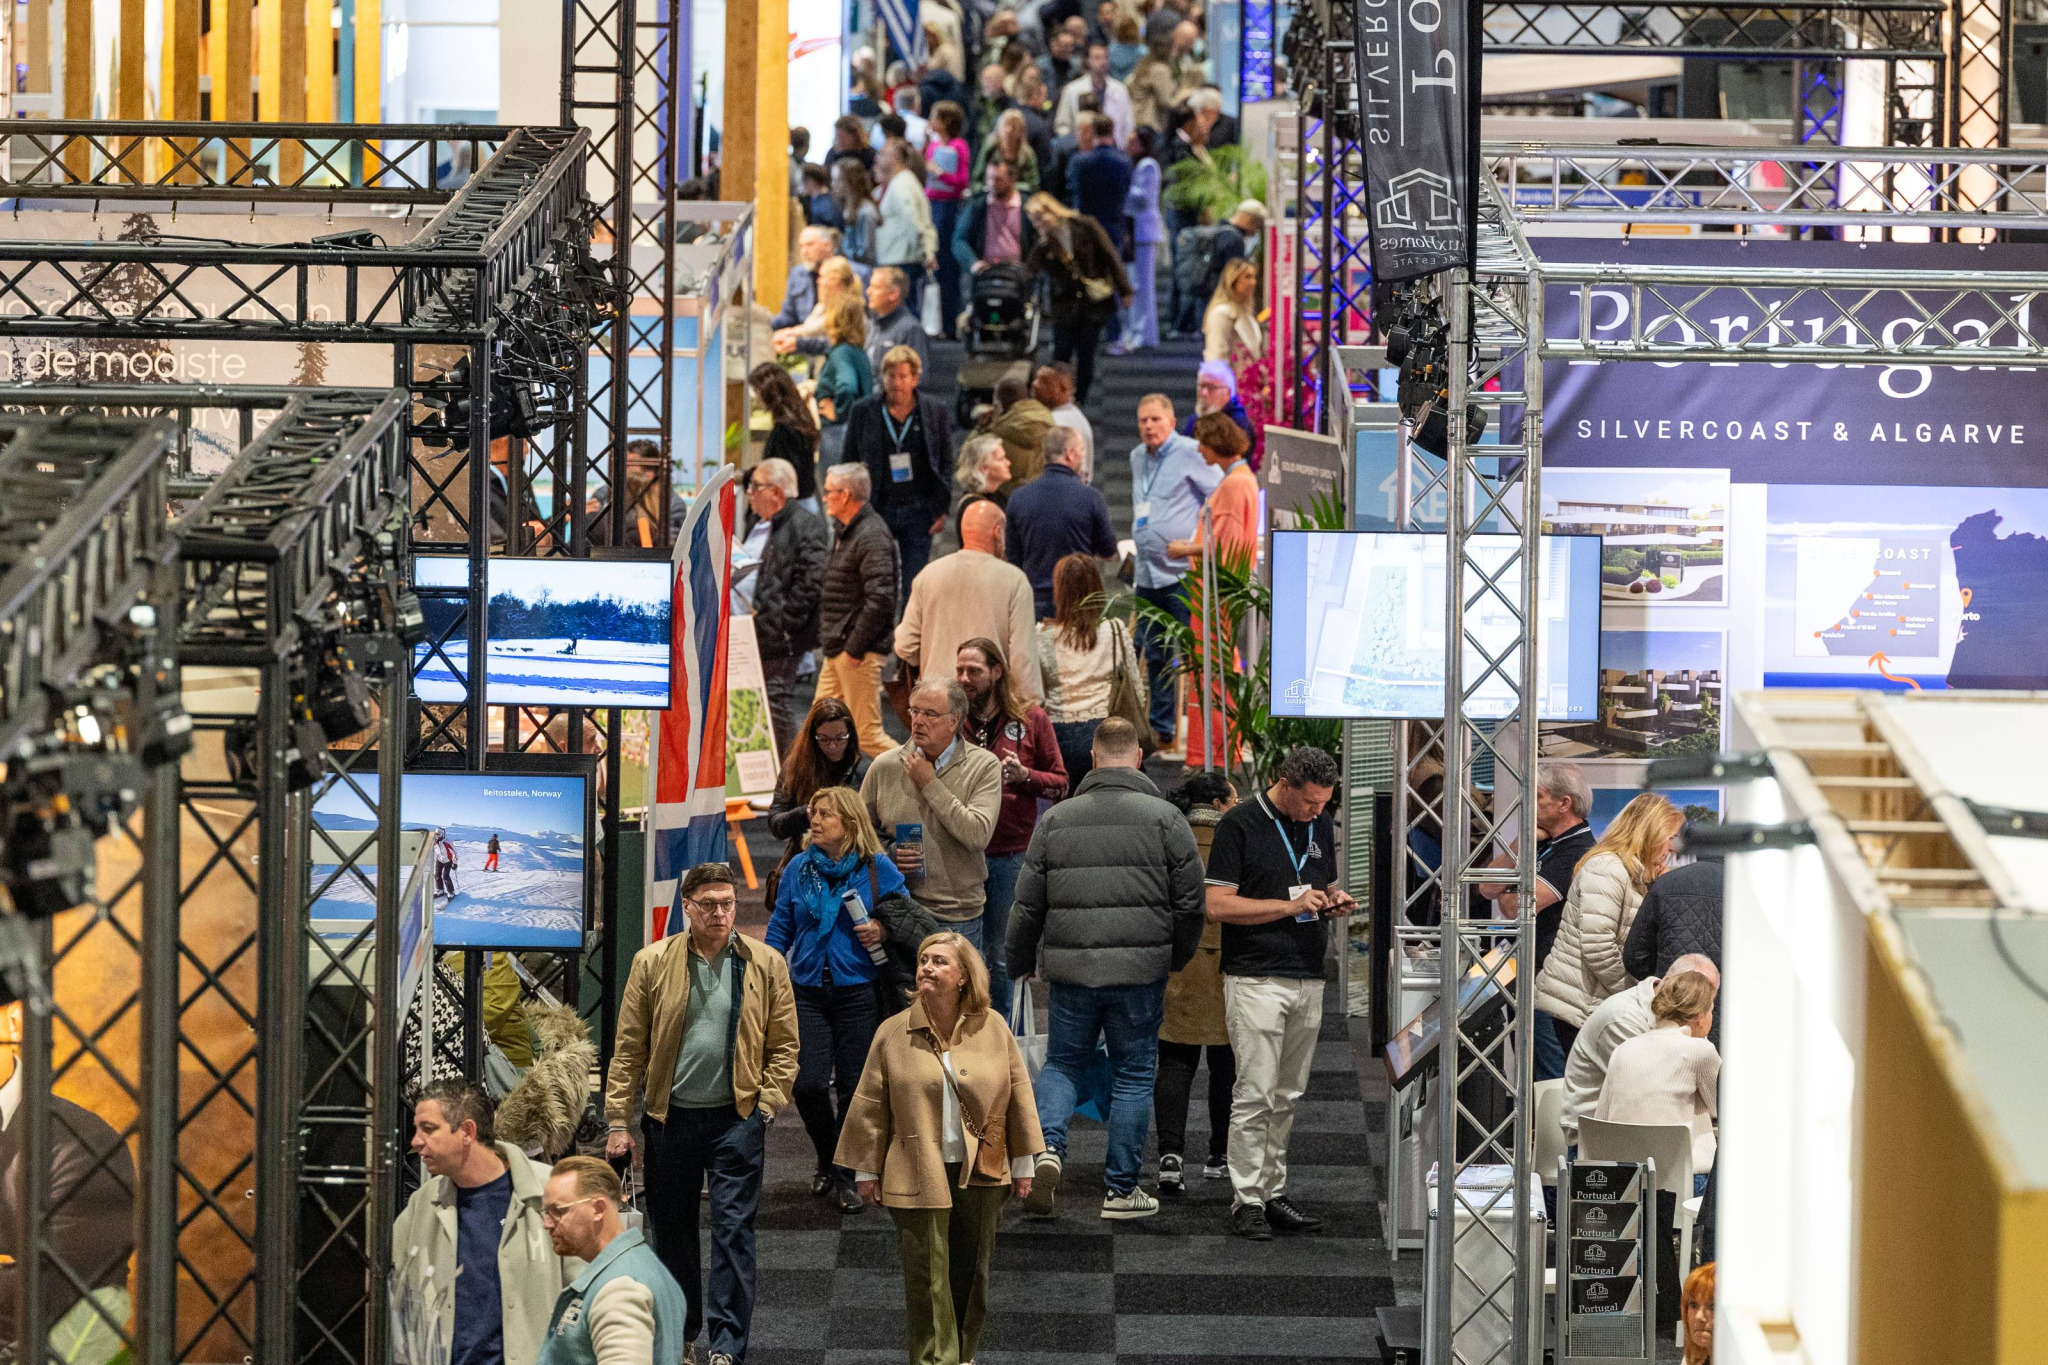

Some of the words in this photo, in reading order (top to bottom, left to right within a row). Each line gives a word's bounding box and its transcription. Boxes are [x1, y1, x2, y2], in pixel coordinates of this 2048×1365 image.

[1567, 288, 2038, 400] Portugal
[26, 339, 77, 378] de
[88, 344, 247, 379] mooiste
[1576, 418, 1813, 443] SILVERCOAST
[1833, 421, 1850, 443] &
[1870, 422, 2026, 446] ALGARVE
[483, 788, 530, 798] Beitostølen,
[531, 789, 562, 799] Norway
[1576, 1190, 1617, 1201] Portugal
[1576, 1227, 1616, 1239] Portugal
[1574, 1264, 1615, 1276] Portugal
[1578, 1302, 1619, 1314] Portugal
